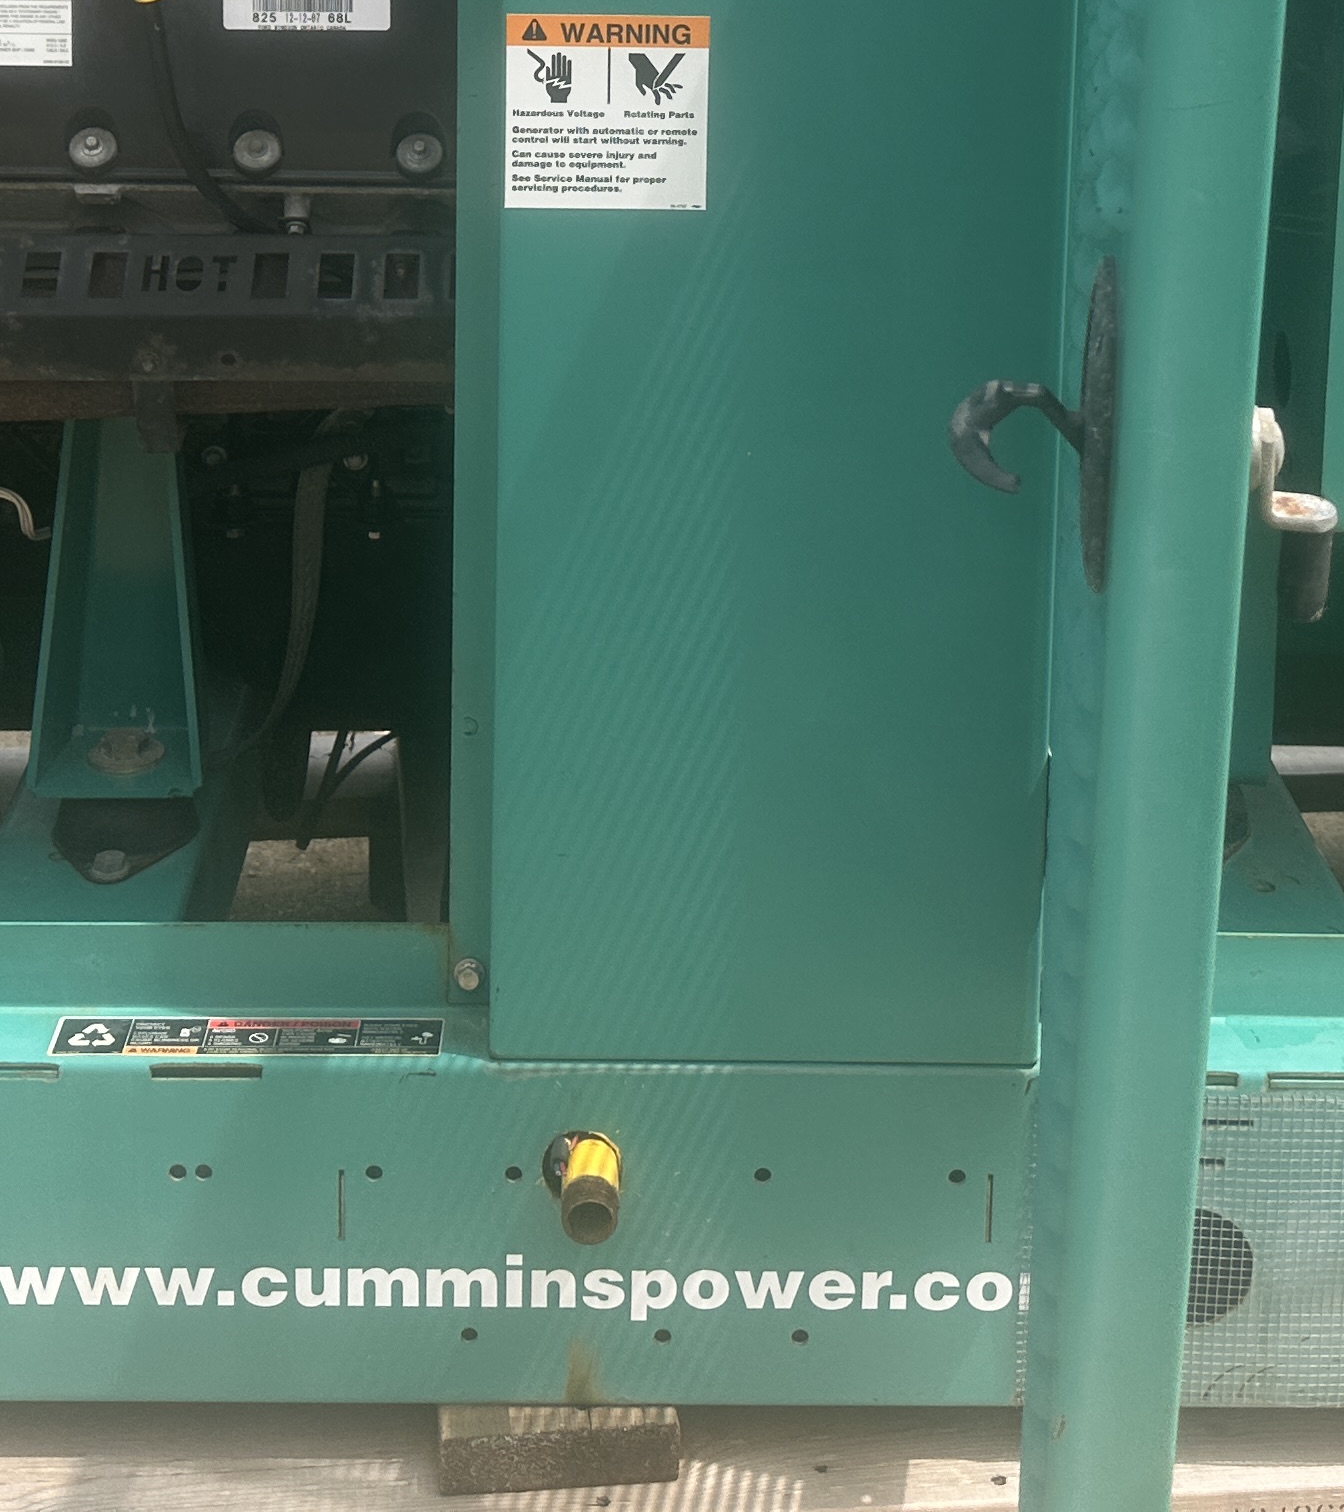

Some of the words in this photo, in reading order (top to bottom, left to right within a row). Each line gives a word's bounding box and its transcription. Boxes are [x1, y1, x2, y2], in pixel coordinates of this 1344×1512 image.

[252, 13, 277, 23] 825
[328, 13, 352, 24] 68L
[561, 23, 691, 45] WARNING
[513, 109, 564, 117] Hazardous
[567, 110, 605, 119] Voltage
[624, 111, 666, 120] Rotating
[669, 111, 695, 119] Parts
[512, 126, 564, 135] Generator
[567, 127, 590, 135] with
[592, 127, 644, 136] automatic
[661, 128, 698, 136] remote
[512, 136, 549, 144] control
[573, 137, 597, 145] start
[601, 137, 640, 145] without
[643, 138, 687, 147] warning.
[512, 150, 532, 158] Can
[606, 151, 635, 160] injury
[512, 160, 553, 169] damage
[569, 161, 626, 170] equipment.
[576, 175, 613, 183] Manual
[633, 177, 667, 185] proper
[512, 185, 559, 193] servicing
[561, 185, 622, 193] procedures.
[141, 255, 237, 291] HOT
